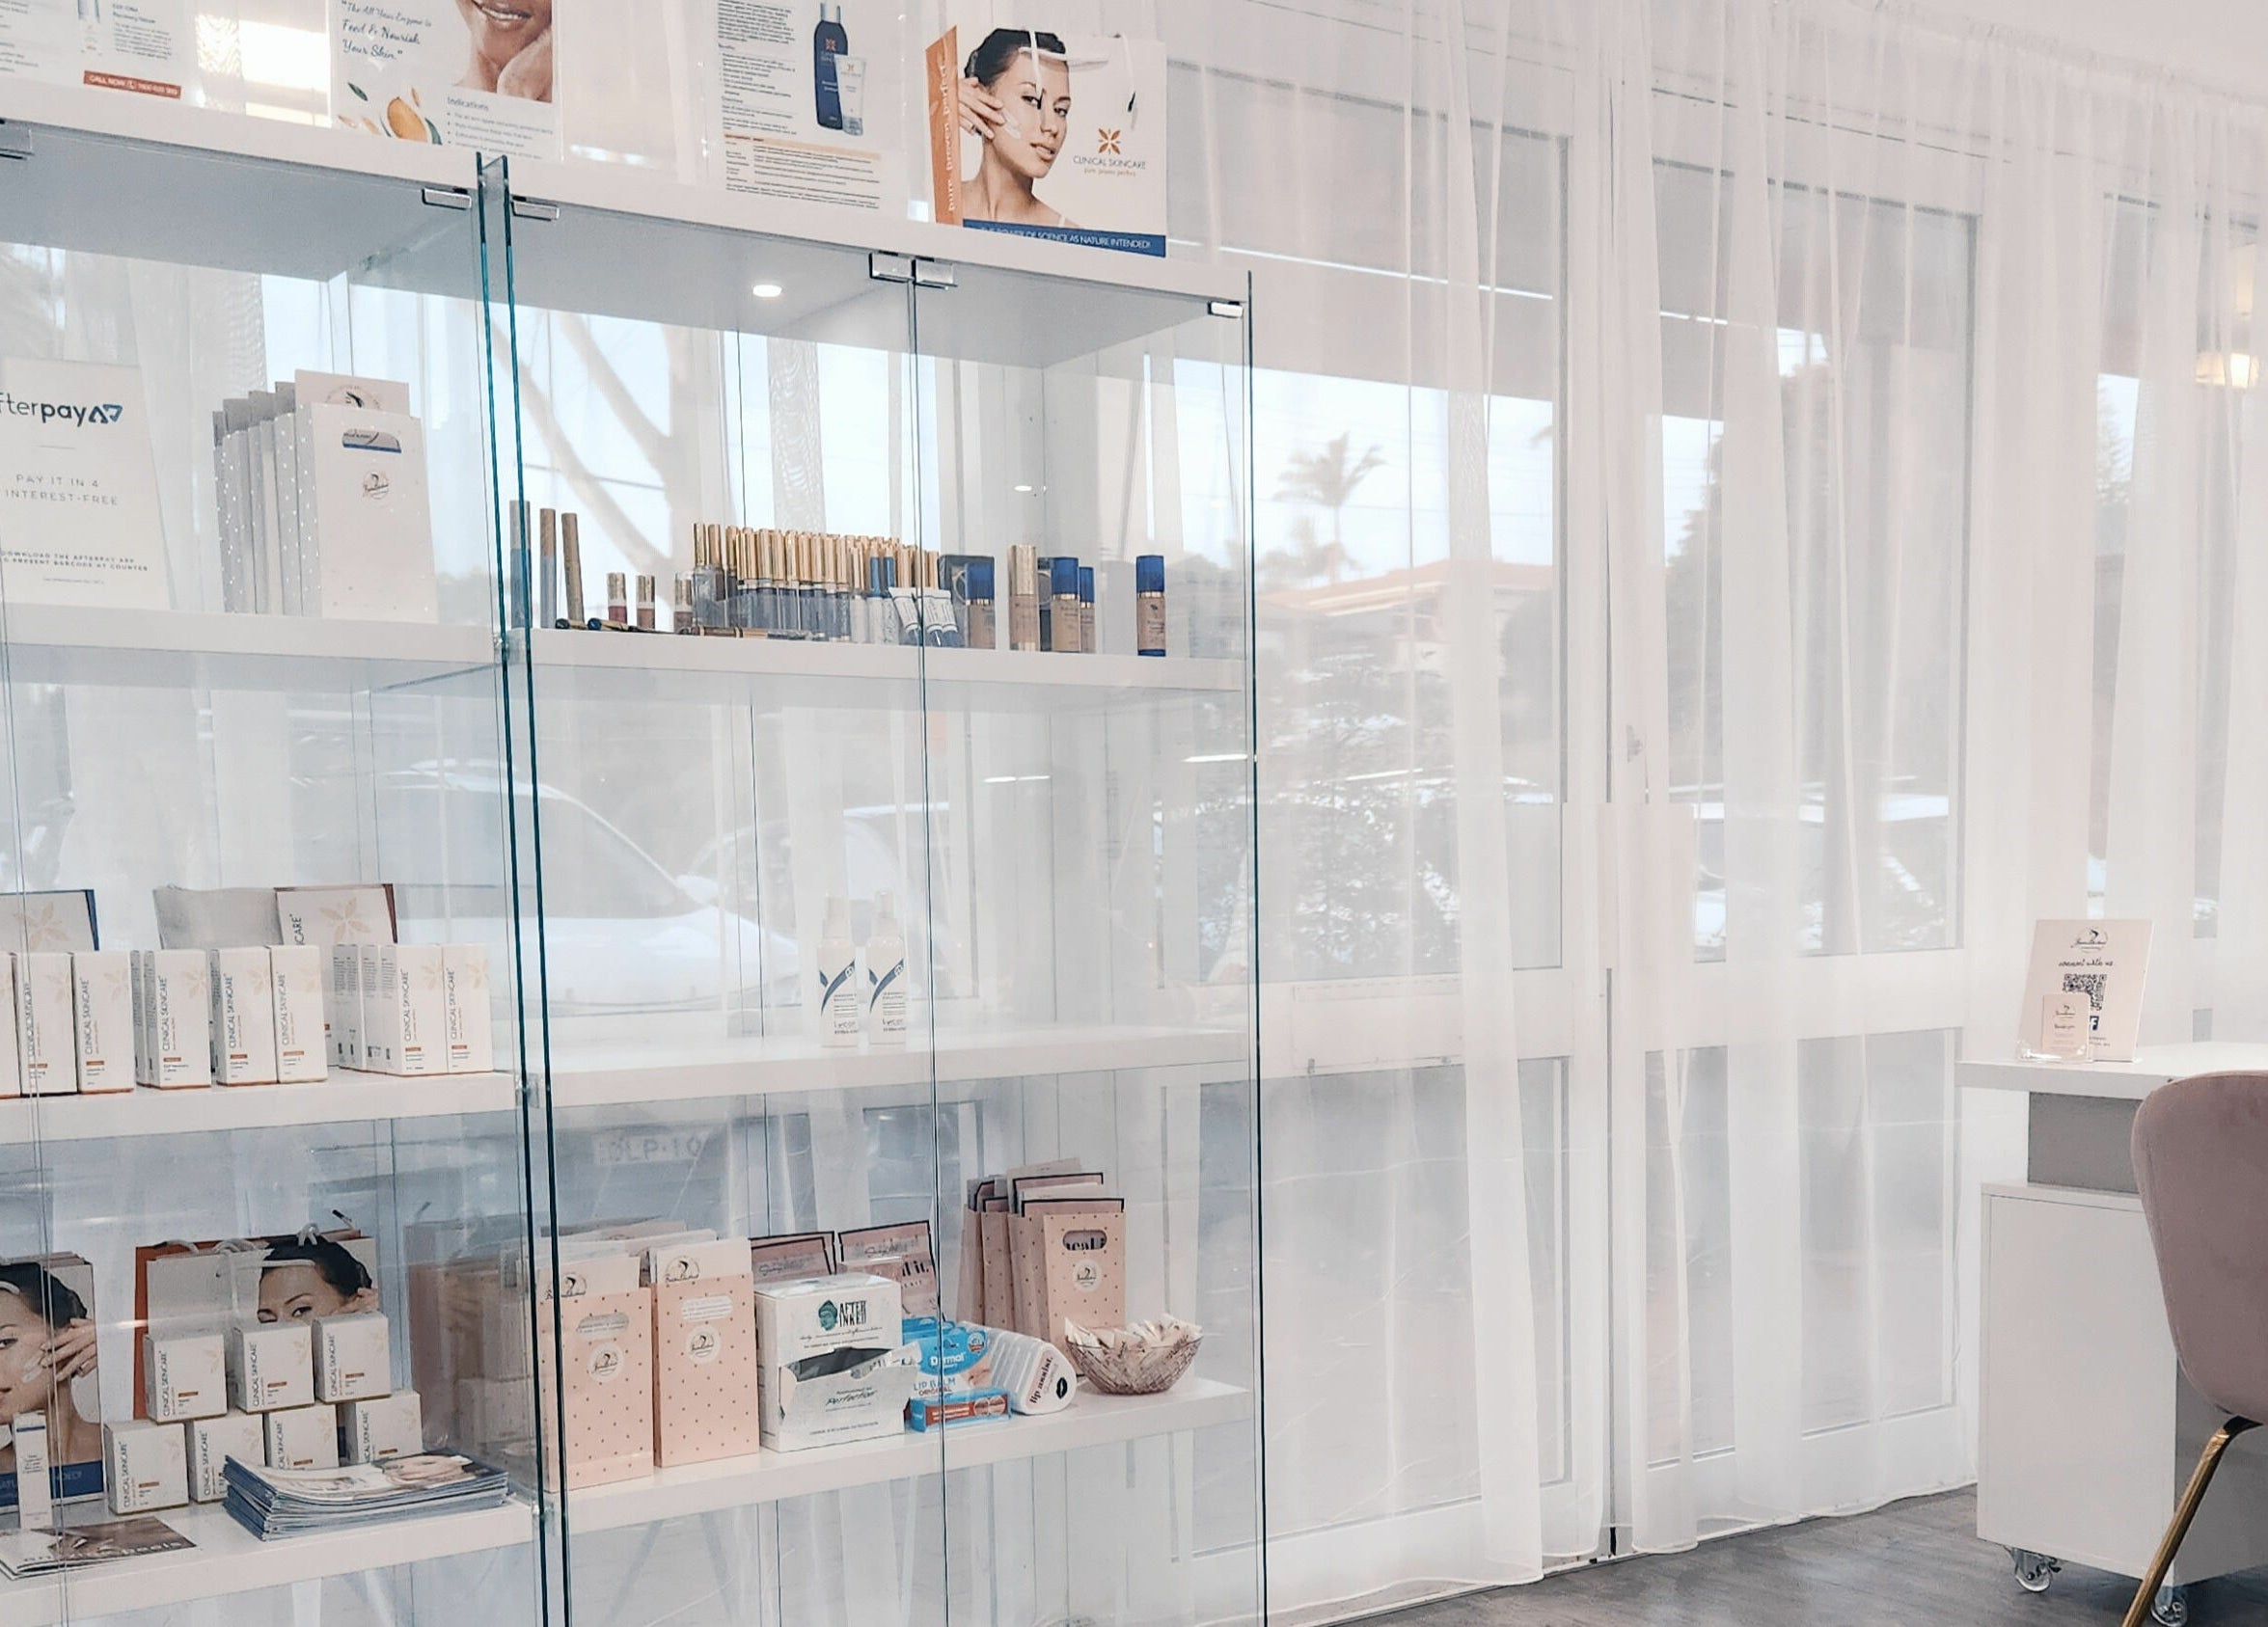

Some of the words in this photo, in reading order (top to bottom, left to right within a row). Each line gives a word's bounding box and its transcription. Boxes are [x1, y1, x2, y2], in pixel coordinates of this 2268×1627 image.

[943, 122, 954, 171] proven
[1073, 154, 1107, 167] CLINICAL
[1108, 158, 1145, 171] SKINCARE
[947, 178, 956, 211] pure
[0, 393, 88, 427] fterpay
[15, 474, 44, 484] PAY
[51, 476, 64, 487] IT
[91, 479, 100, 488] 4
[5, 489, 119, 506] INTEREST-FREE
[838, 1300, 867, 1315] AFTER
[838, 1311, 867, 1327] INKED
[913, 1381, 927, 1391] LIP
[1029, 1390, 1042, 1404] lip
